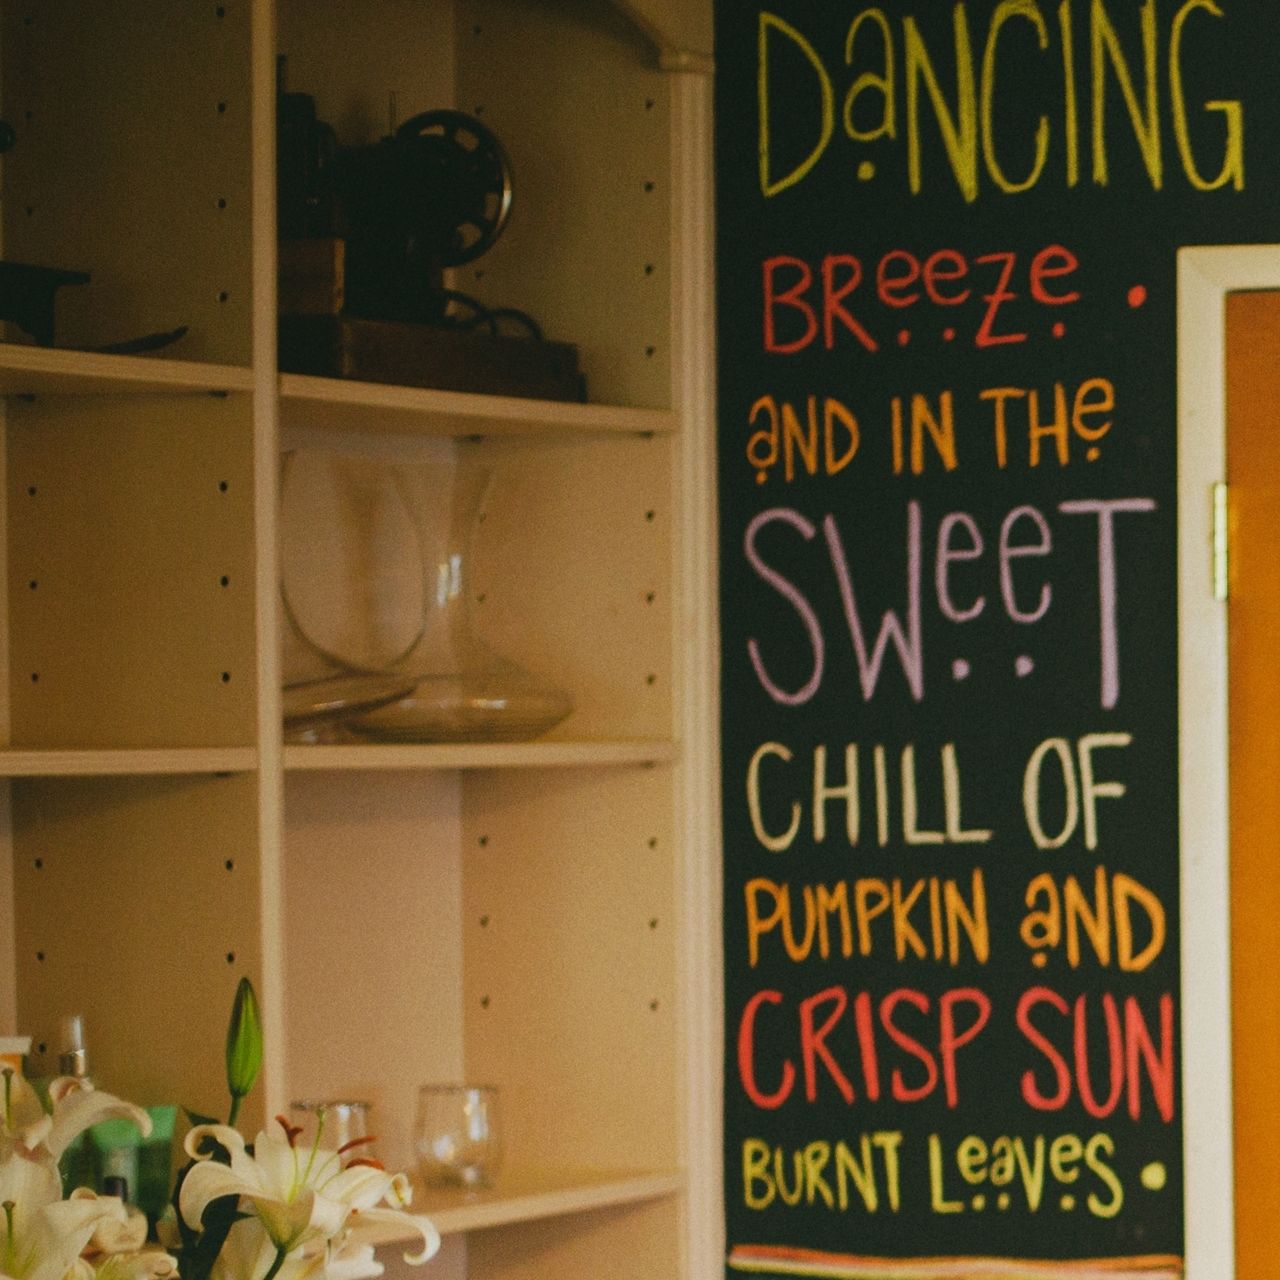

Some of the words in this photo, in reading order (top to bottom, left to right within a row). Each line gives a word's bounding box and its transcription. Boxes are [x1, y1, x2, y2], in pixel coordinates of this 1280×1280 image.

[892, 391, 958, 475] IN
[746, 741, 994, 853] CHILL
[1022, 732, 1134, 852] OF
[743, 868, 990, 968] PUMPKIN
[738, 986, 992, 1109] CRISP
[1015, 986, 1176, 1123] SUN
[742, 1131, 902, 1212] BURNT
